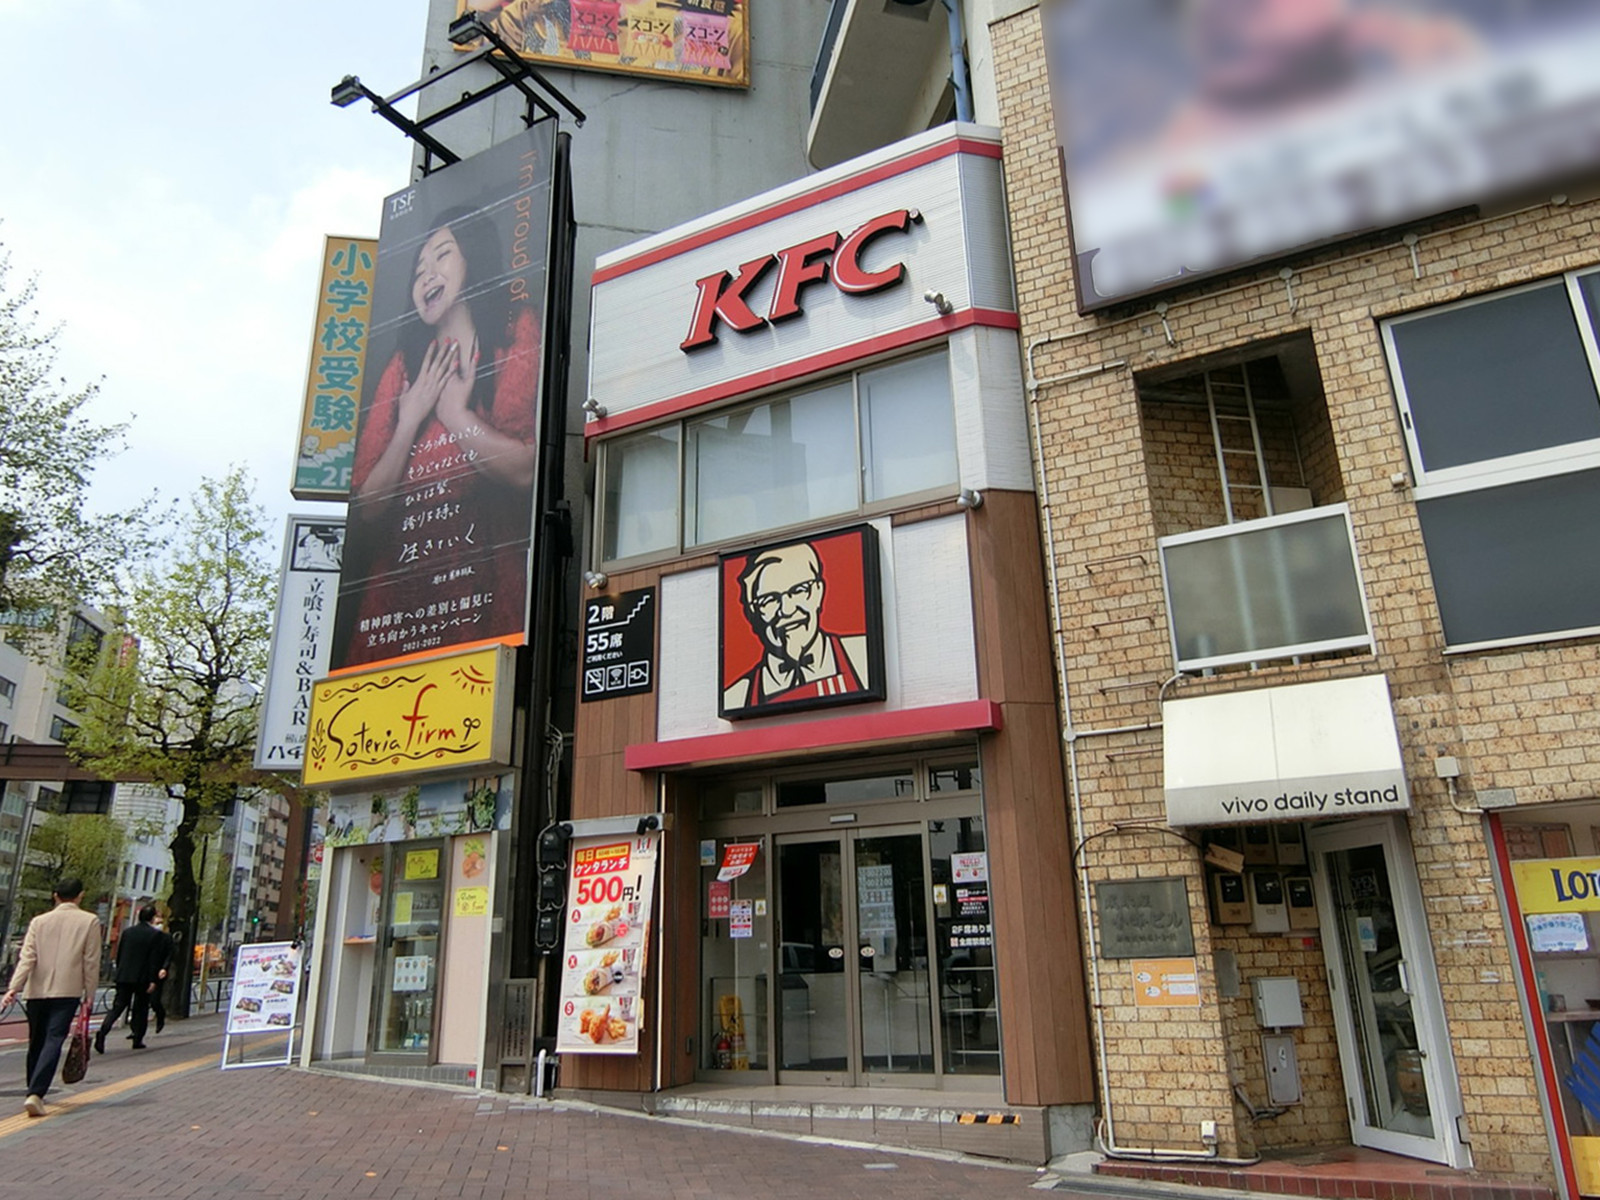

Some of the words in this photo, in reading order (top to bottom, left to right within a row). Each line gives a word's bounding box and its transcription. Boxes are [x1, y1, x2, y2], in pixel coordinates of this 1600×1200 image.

[576, 12, 615, 28] スコーン
[631, 18, 671, 34] スコーン
[687, 26, 725, 41] スコーン
[390, 189, 416, 213] TSF
[511, 195, 531, 269] proud
[510, 277, 529, 302] of
[679, 209, 908, 354] KFC
[310, 243, 372, 431] 小学校受験
[321, 466, 352, 487] 2F
[402, 503, 461, 531] 誇りを持って
[398, 523, 476, 563] 生きていく
[360, 592, 494, 633] 精神障害への差別と偏見に
[588, 605, 615, 624] 2階
[367, 613, 482, 647] 立ち向かうキャンペーン
[586, 632, 623, 653] 55席
[402, 636, 441, 652] 2021-2022
[327, 697, 401, 762] Soteria
[1221, 797, 1268, 814] vivo
[1274, 791, 1329, 811] daily
[1334, 784, 1399, 807] stand
[575, 856, 627, 876] ケンタランチ
[1550, 868, 1600, 902] LOT
